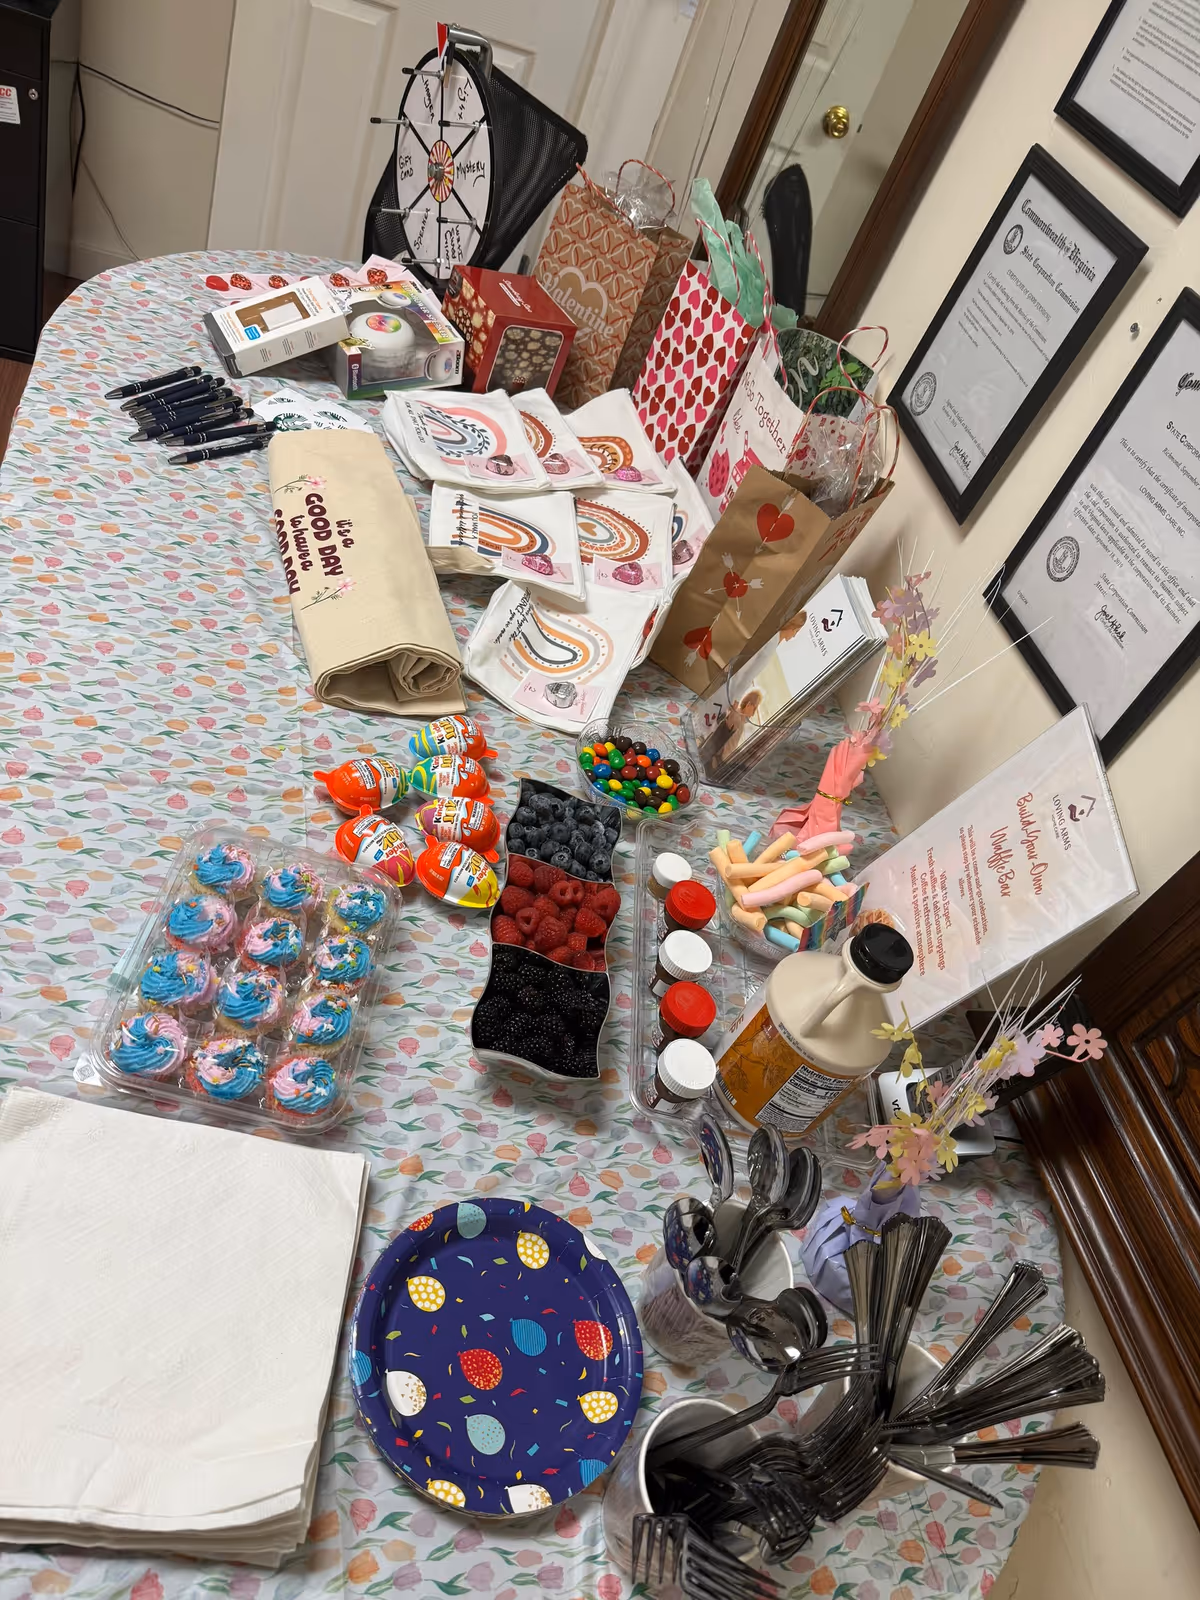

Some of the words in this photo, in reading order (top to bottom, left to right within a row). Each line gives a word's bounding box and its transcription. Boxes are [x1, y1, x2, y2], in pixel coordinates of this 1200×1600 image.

[1068, 244, 1096, 281] Virginia
[1019, 245, 1034, 262] State
[1032, 257, 1055, 287] Corporation
[1055, 282, 1080, 314] Commission
[542, 271, 616, 338] Valentine
[750, 392, 786, 453] Together
[289, 515, 305, 529] to
[305, 493, 333, 542] GOOD
[1138, 484, 1156, 504] LOVING
[1153, 501, 1167, 517] ARMS
[1164, 513, 1178, 529] CARE
[1175, 525, 1186, 539] INC.
[292, 527, 311, 560] have
[341, 538, 355, 549] a
[300, 558, 314, 572] a
[318, 544, 344, 577] DAY
[809, 612, 820, 640] LOVING
[817, 637, 829, 657] ARMS
[1053, 794, 1066, 828] LOVING
[1060, 827, 1072, 851] ARMS
[385, 842, 408, 860] inder
[926, 847, 935, 868] Fresh
[987, 826, 1014, 873] Waffle
[474, 862, 491, 883] inder
[909, 864, 918, 887] Music
[920, 872, 928, 896] Coffee
[929, 867, 937, 893] waffles
[939, 870, 948, 892] What
[998, 869, 1015, 897] Bar
[922, 895, 929, 904] &
[931, 893, 938, 901] &
[941, 891, 948, 902] to
[912, 898, 921, 929] positive
[923, 902, 934, 954] refreshments
[932, 900, 942, 935] delicious
[942, 900, 951, 929] Expect
[916, 929, 925, 976] atmosphere
[935, 934, 946, 970] toppings
[790, 1079, 816, 1094] Calories
[800, 1065, 832, 1082] Nutrition
